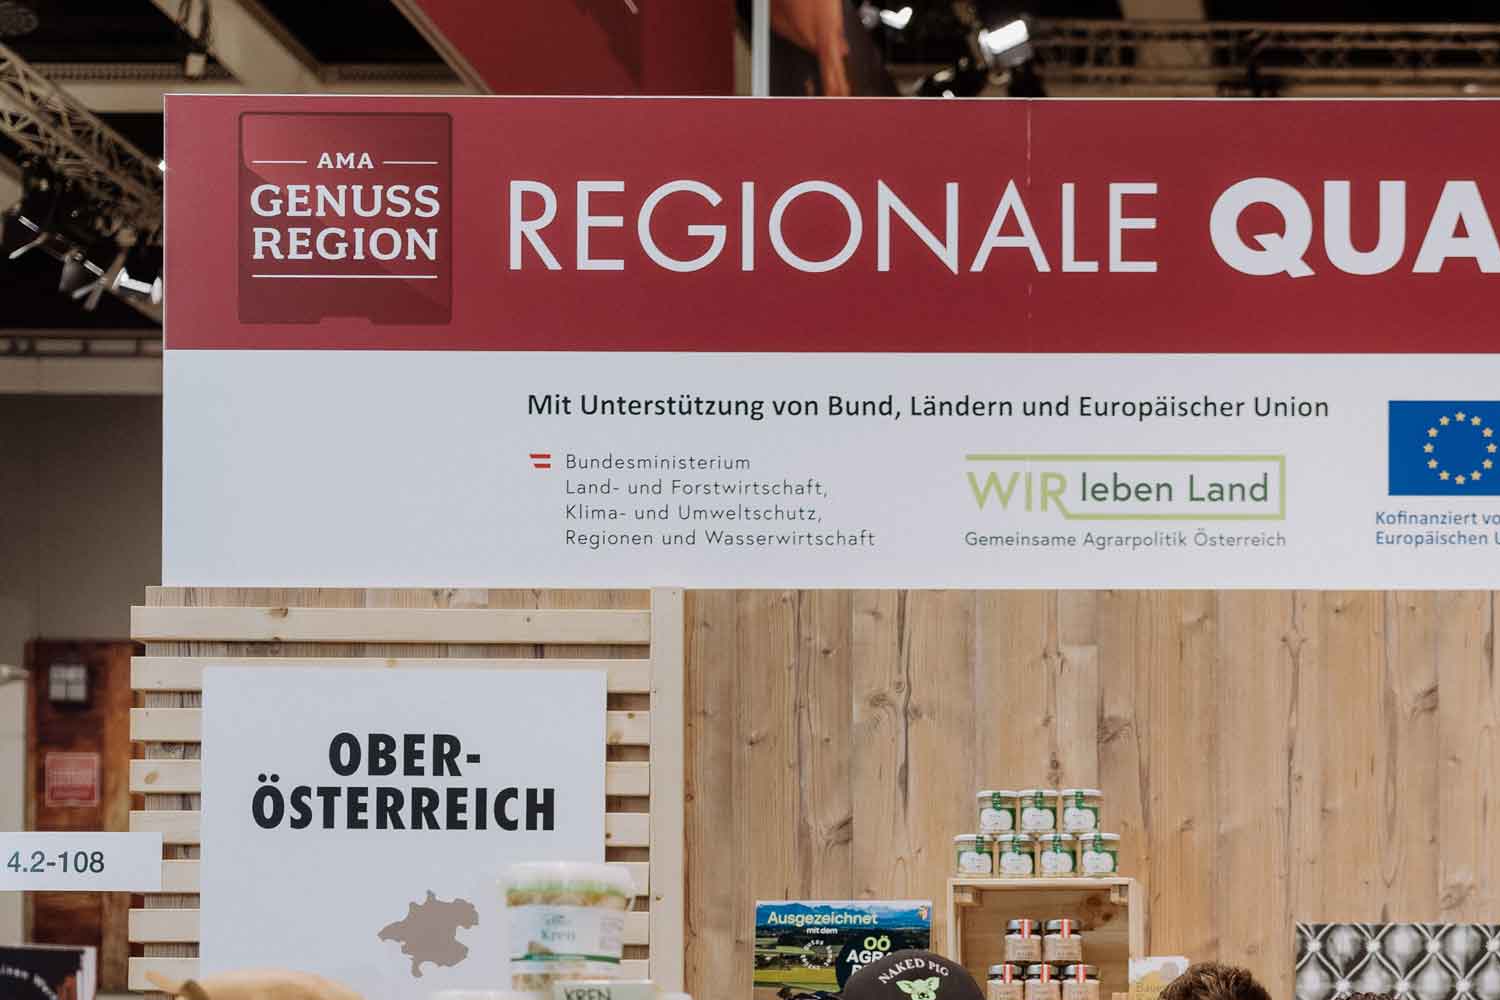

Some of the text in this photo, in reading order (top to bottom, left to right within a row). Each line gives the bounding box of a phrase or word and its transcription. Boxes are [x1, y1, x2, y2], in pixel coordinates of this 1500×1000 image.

[316, 152, 375, 169] AMA
[250, 183, 440, 218] GENUSS
[509, 178, 1158, 275] REGIONALE
[252, 226, 438, 261] REGION
[528, 393, 1329, 422] Mit Unterstützung von Bund, Ländern und Europäischer Union
[566, 452, 750, 470] Bundesministerium
[566, 478, 827, 498] Land- und Forstwirtschaft,
[964, 471, 1268, 514] WIR leben Land
[566, 503, 822, 523] Klima- und Umweltschutz,
[1375, 509, 1478, 526] Kofinanziert
[566, 528, 876, 550] Regionen und Wasserwirtschaft
[964, 527, 1286, 551] Gemeinsame Agrarpolitik Österreich
[1375, 530, 1488, 549] Europäischen
[328, 731, 481, 777] OBER-
[251, 770, 555, 832] ÖSTERREICH
[7, 850, 105, 874] 4.2-108
[768, 911, 878, 926] Ausgezeichnet
[864, 936, 891, 951] OÖ
[878, 958, 925, 984] NAKED
[928, 960, 950, 976] PIG
